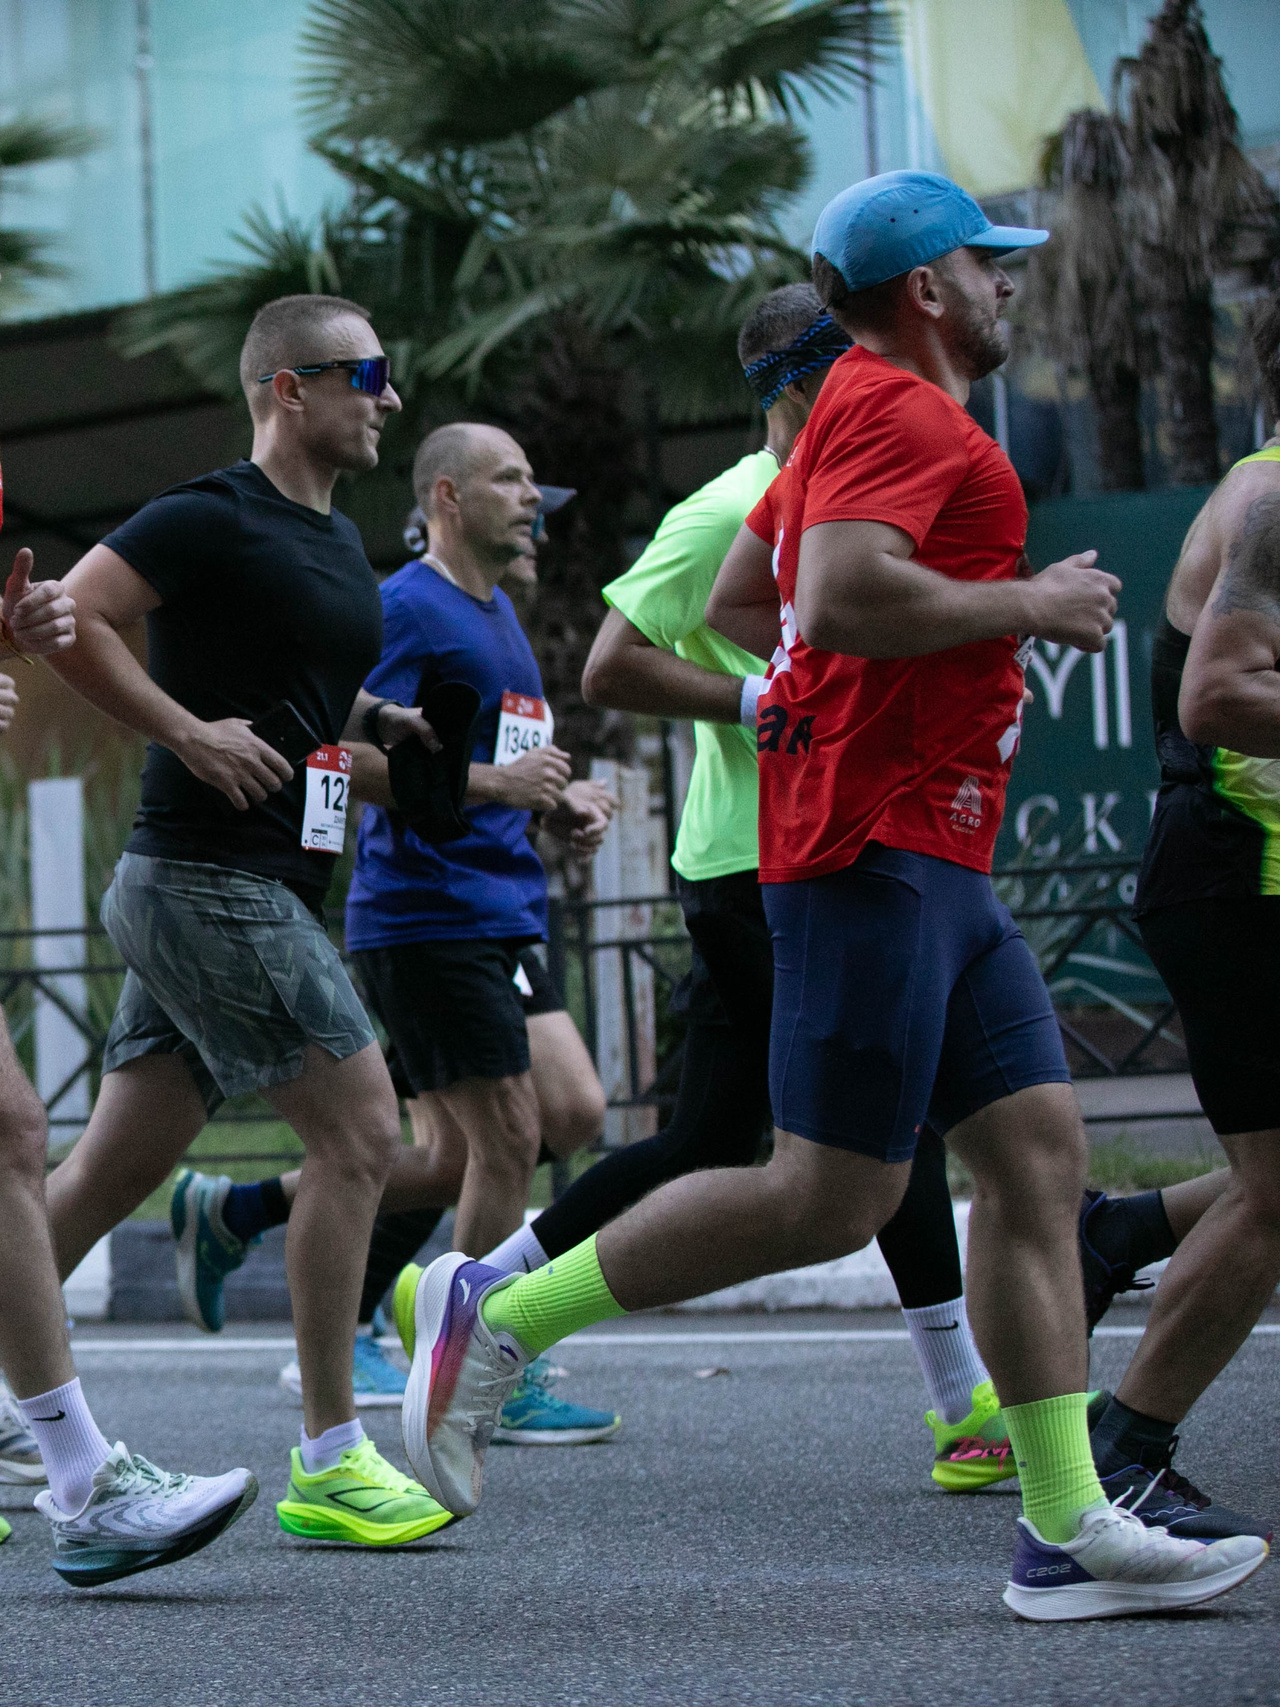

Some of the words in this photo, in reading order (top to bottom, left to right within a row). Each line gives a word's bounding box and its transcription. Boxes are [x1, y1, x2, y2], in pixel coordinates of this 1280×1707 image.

[316, 751, 328, 761] 21.1
[321, 775, 349, 811] 12
[949, 812, 980, 828] AGRO
[1026, 1563, 1071, 1578] C202
